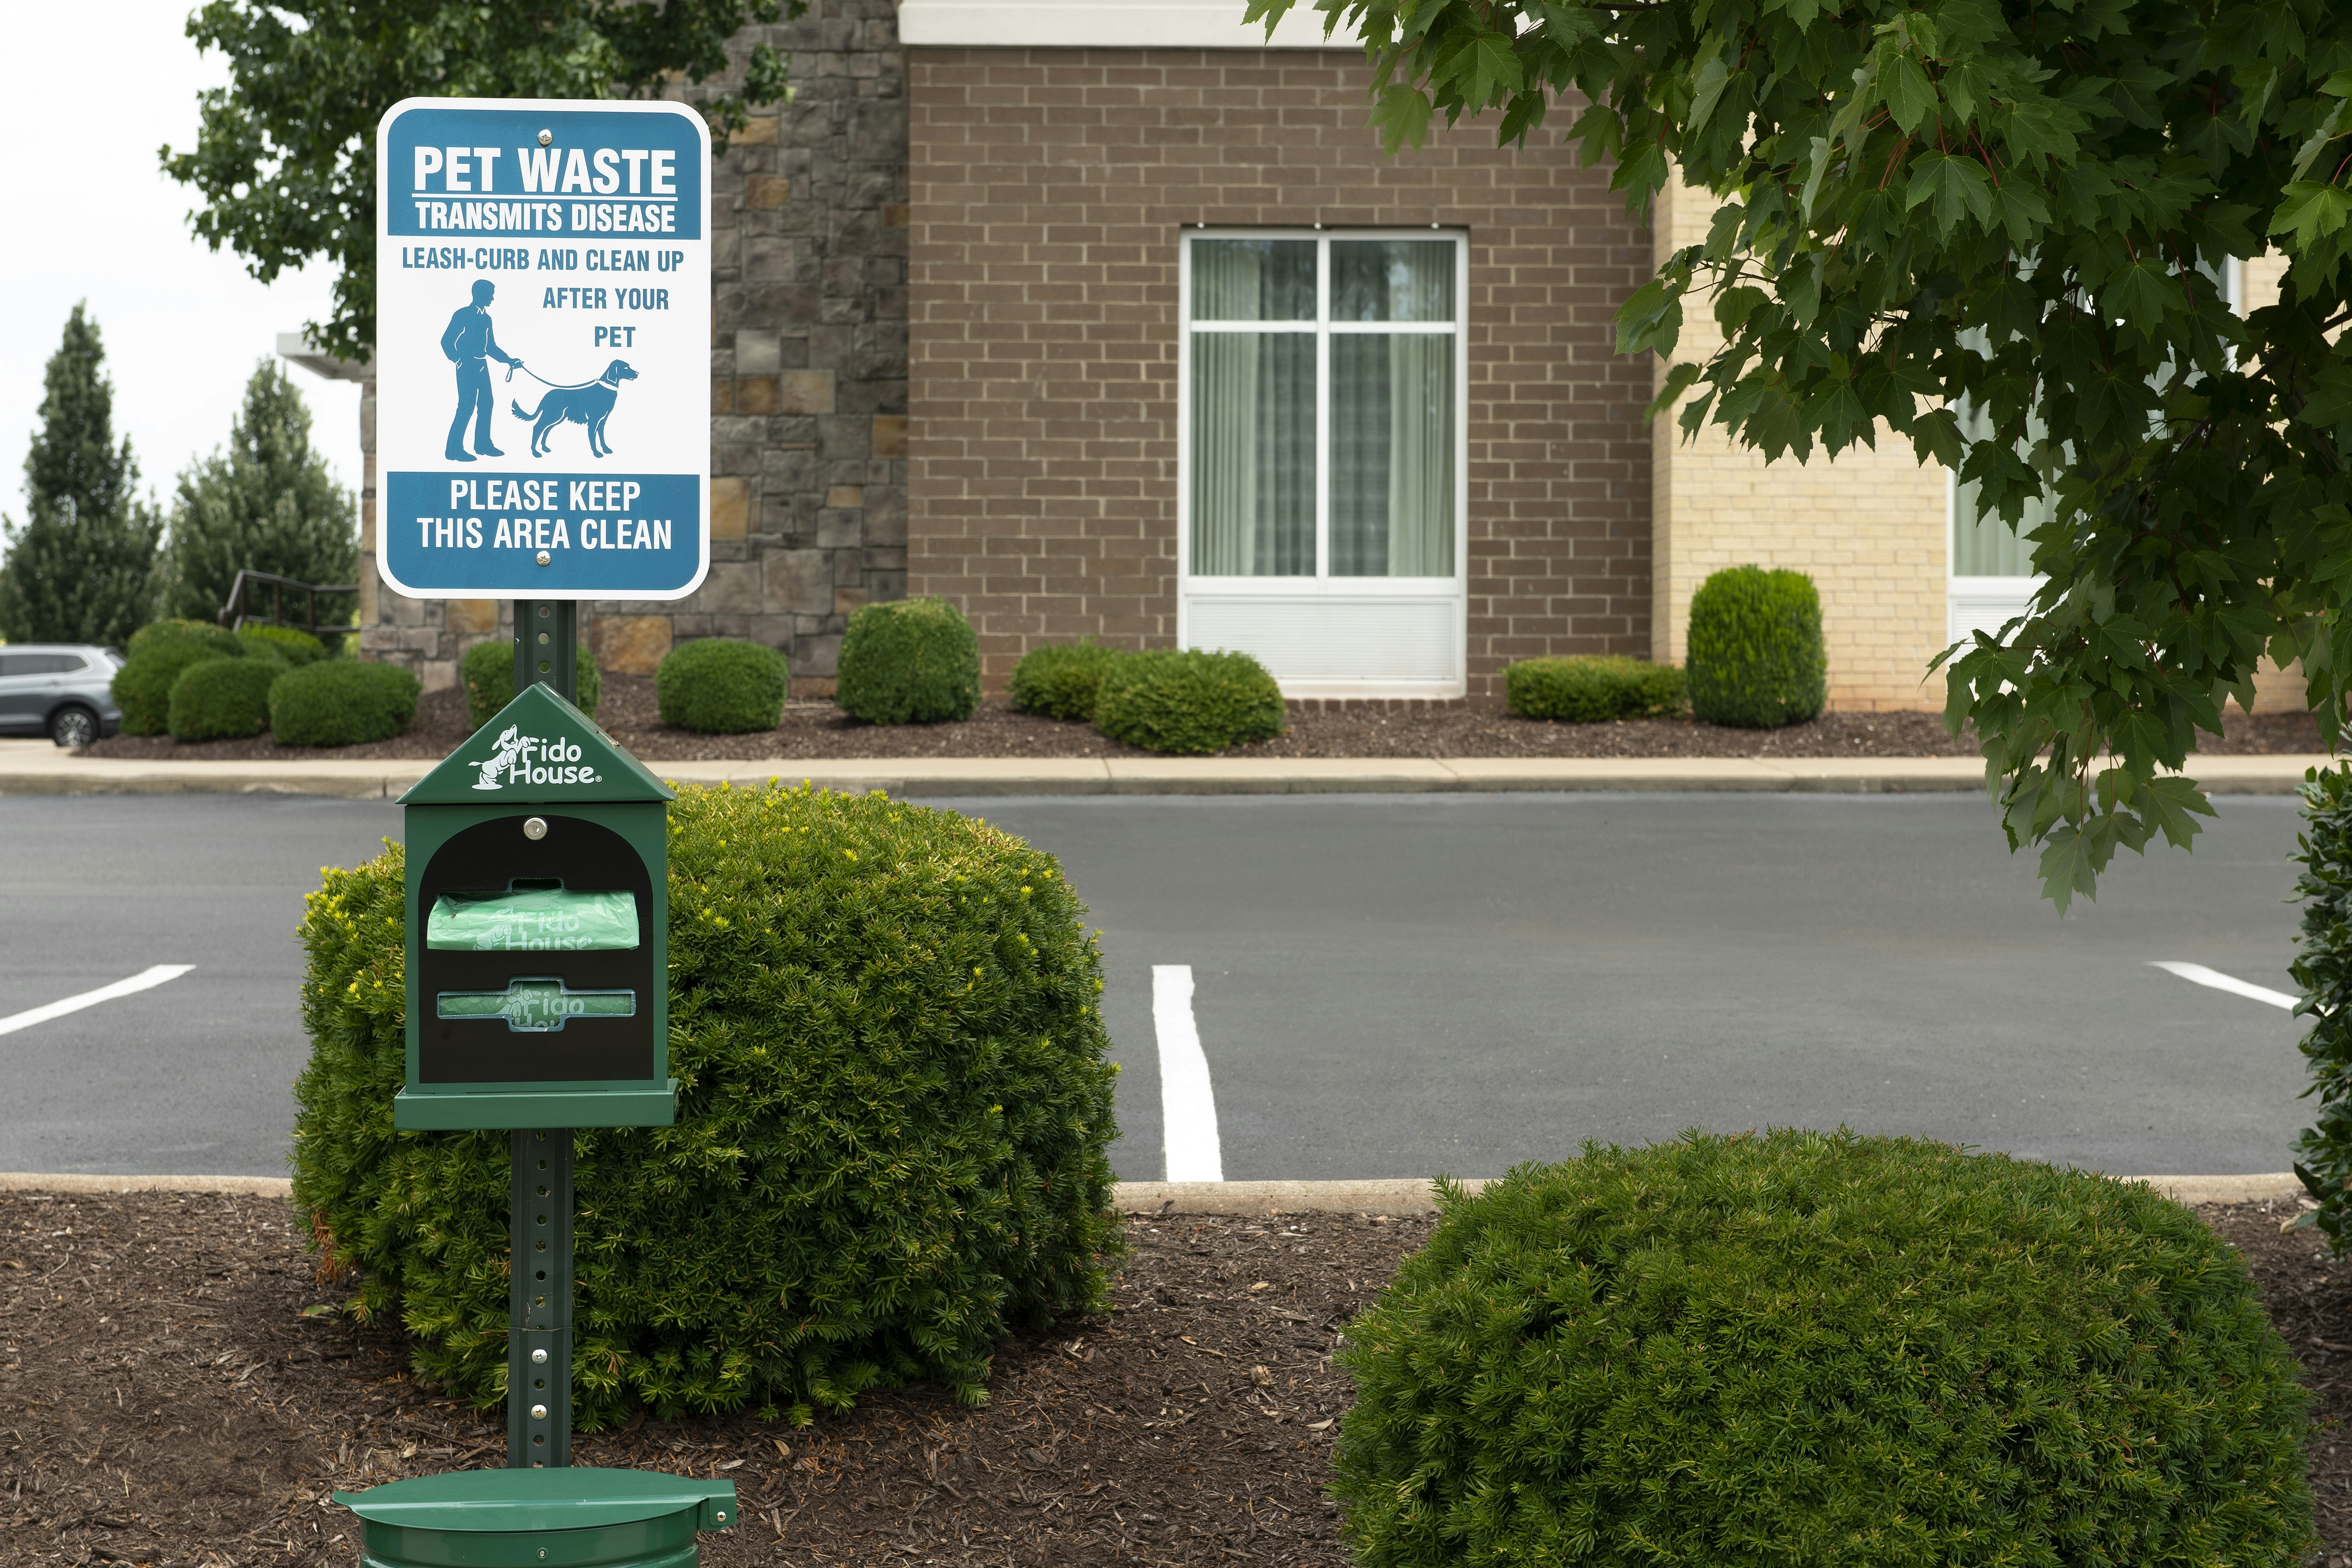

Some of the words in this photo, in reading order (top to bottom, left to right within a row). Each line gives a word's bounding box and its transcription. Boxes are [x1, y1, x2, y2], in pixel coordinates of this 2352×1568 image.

[414, 146, 501, 192] PET
[517, 148, 676, 194] WASTE
[415, 201, 562, 231] TRANSMITS
[572, 204, 675, 232] DISEASE
[403, 247, 529, 270] LEASH-CURB
[537, 249, 577, 270] AND
[586, 249, 649, 271] CLEAN
[658, 250, 684, 272] UP
[543, 287, 607, 309] AFTER
[615, 288, 669, 310] YOUR
[595, 326, 636, 347] PET
[451, 479, 558, 511] PLEASE
[570, 481, 640, 511] KEEP
[416, 517, 483, 549] THIS
[493, 518, 570, 549] AREA
[581, 518, 672, 550] CLEAN
[522, 737, 582, 763] Fido
[518, 910, 580, 934] Fido
[523, 991, 585, 1016] Fido
